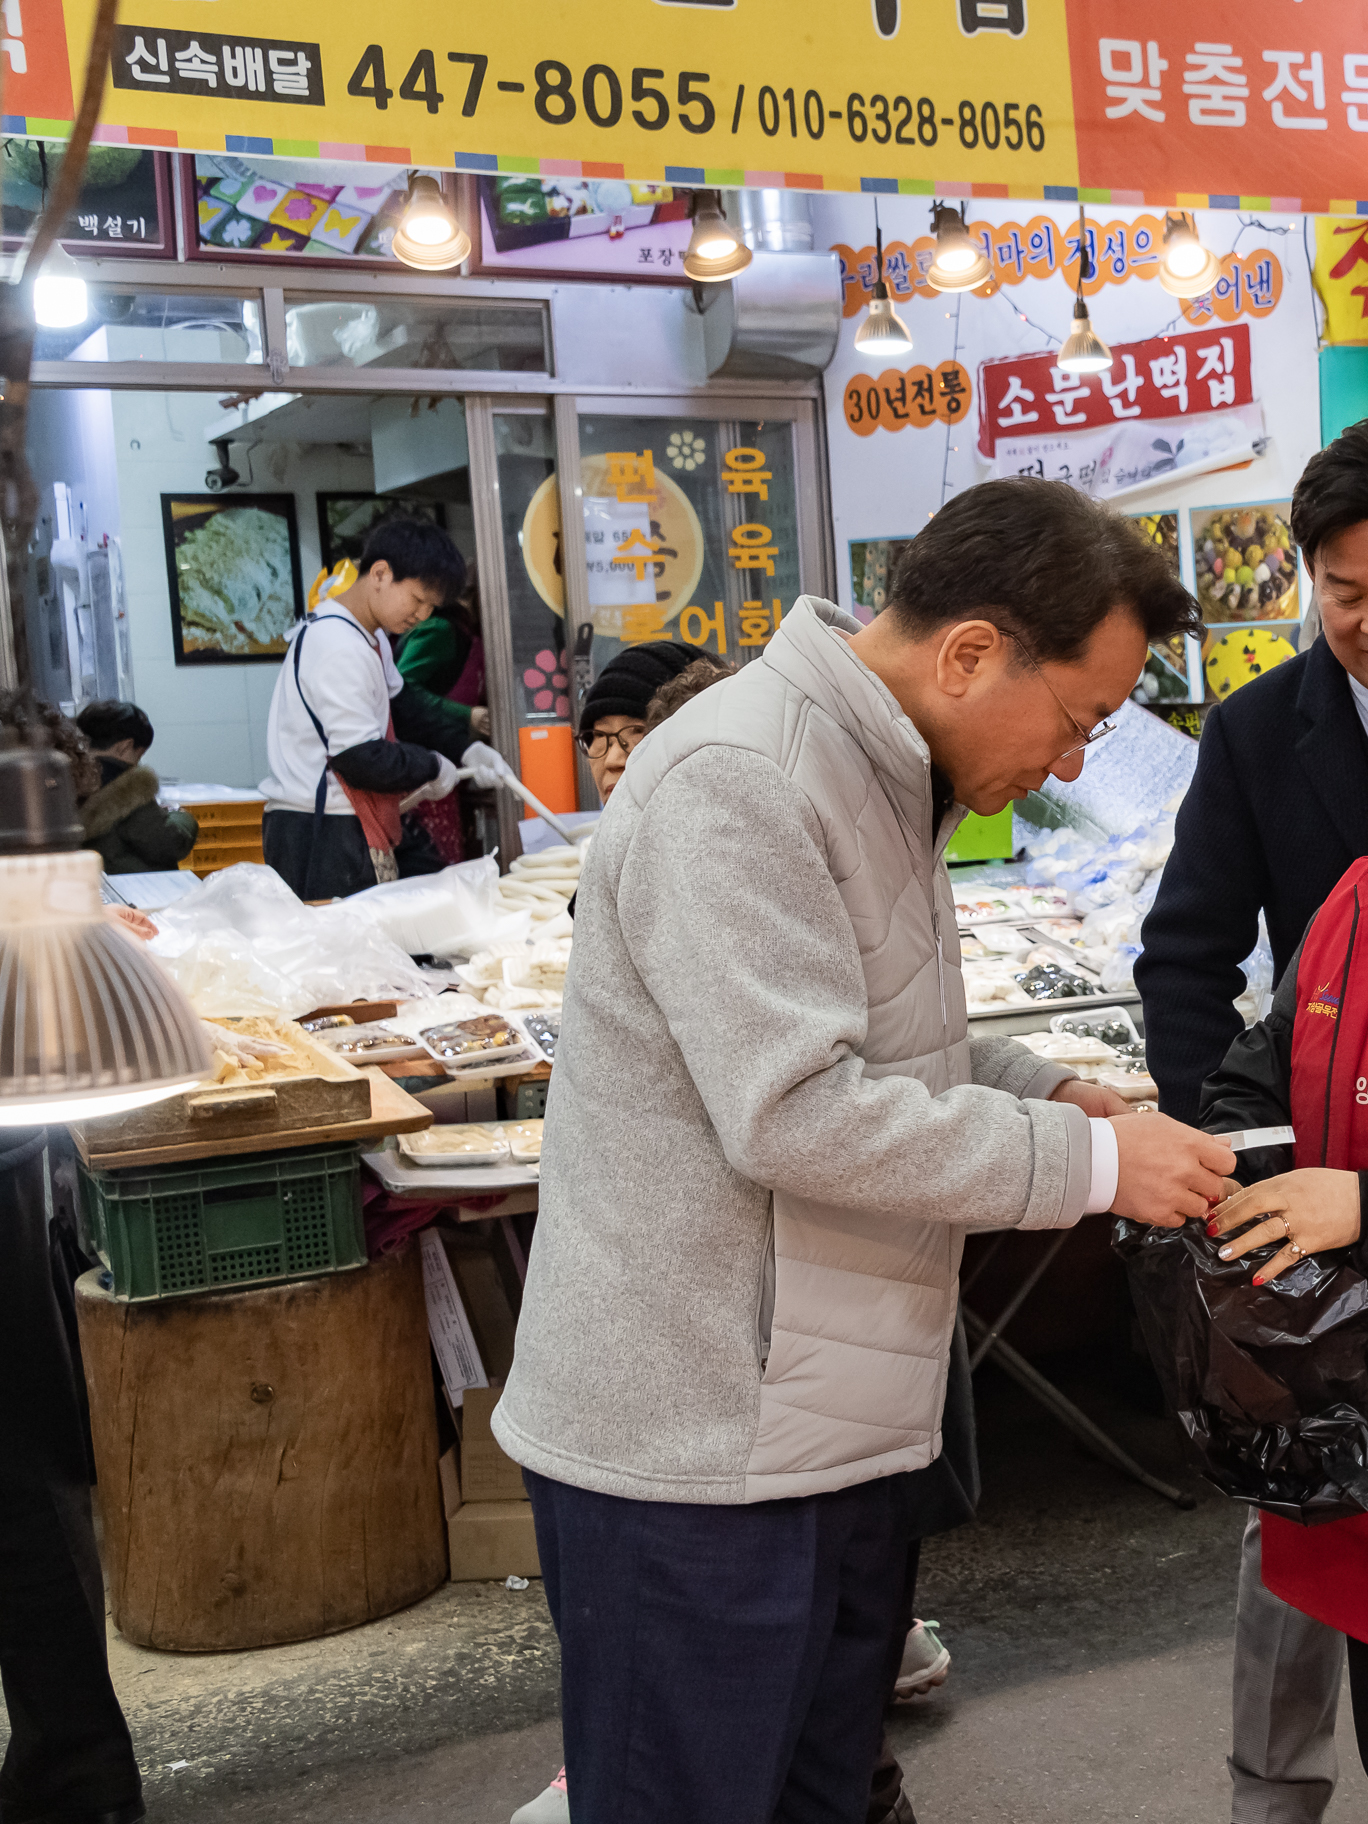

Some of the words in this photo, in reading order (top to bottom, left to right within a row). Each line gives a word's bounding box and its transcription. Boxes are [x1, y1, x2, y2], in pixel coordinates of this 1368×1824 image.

[124, 34, 312, 97] 신속배달
[757, 84, 1046, 152] 010-6328-8056
[78, 214, 146, 239] 백설기
[1064, 229, 1160, 281] 정성으
[848, 366, 967, 424] 30년전통
